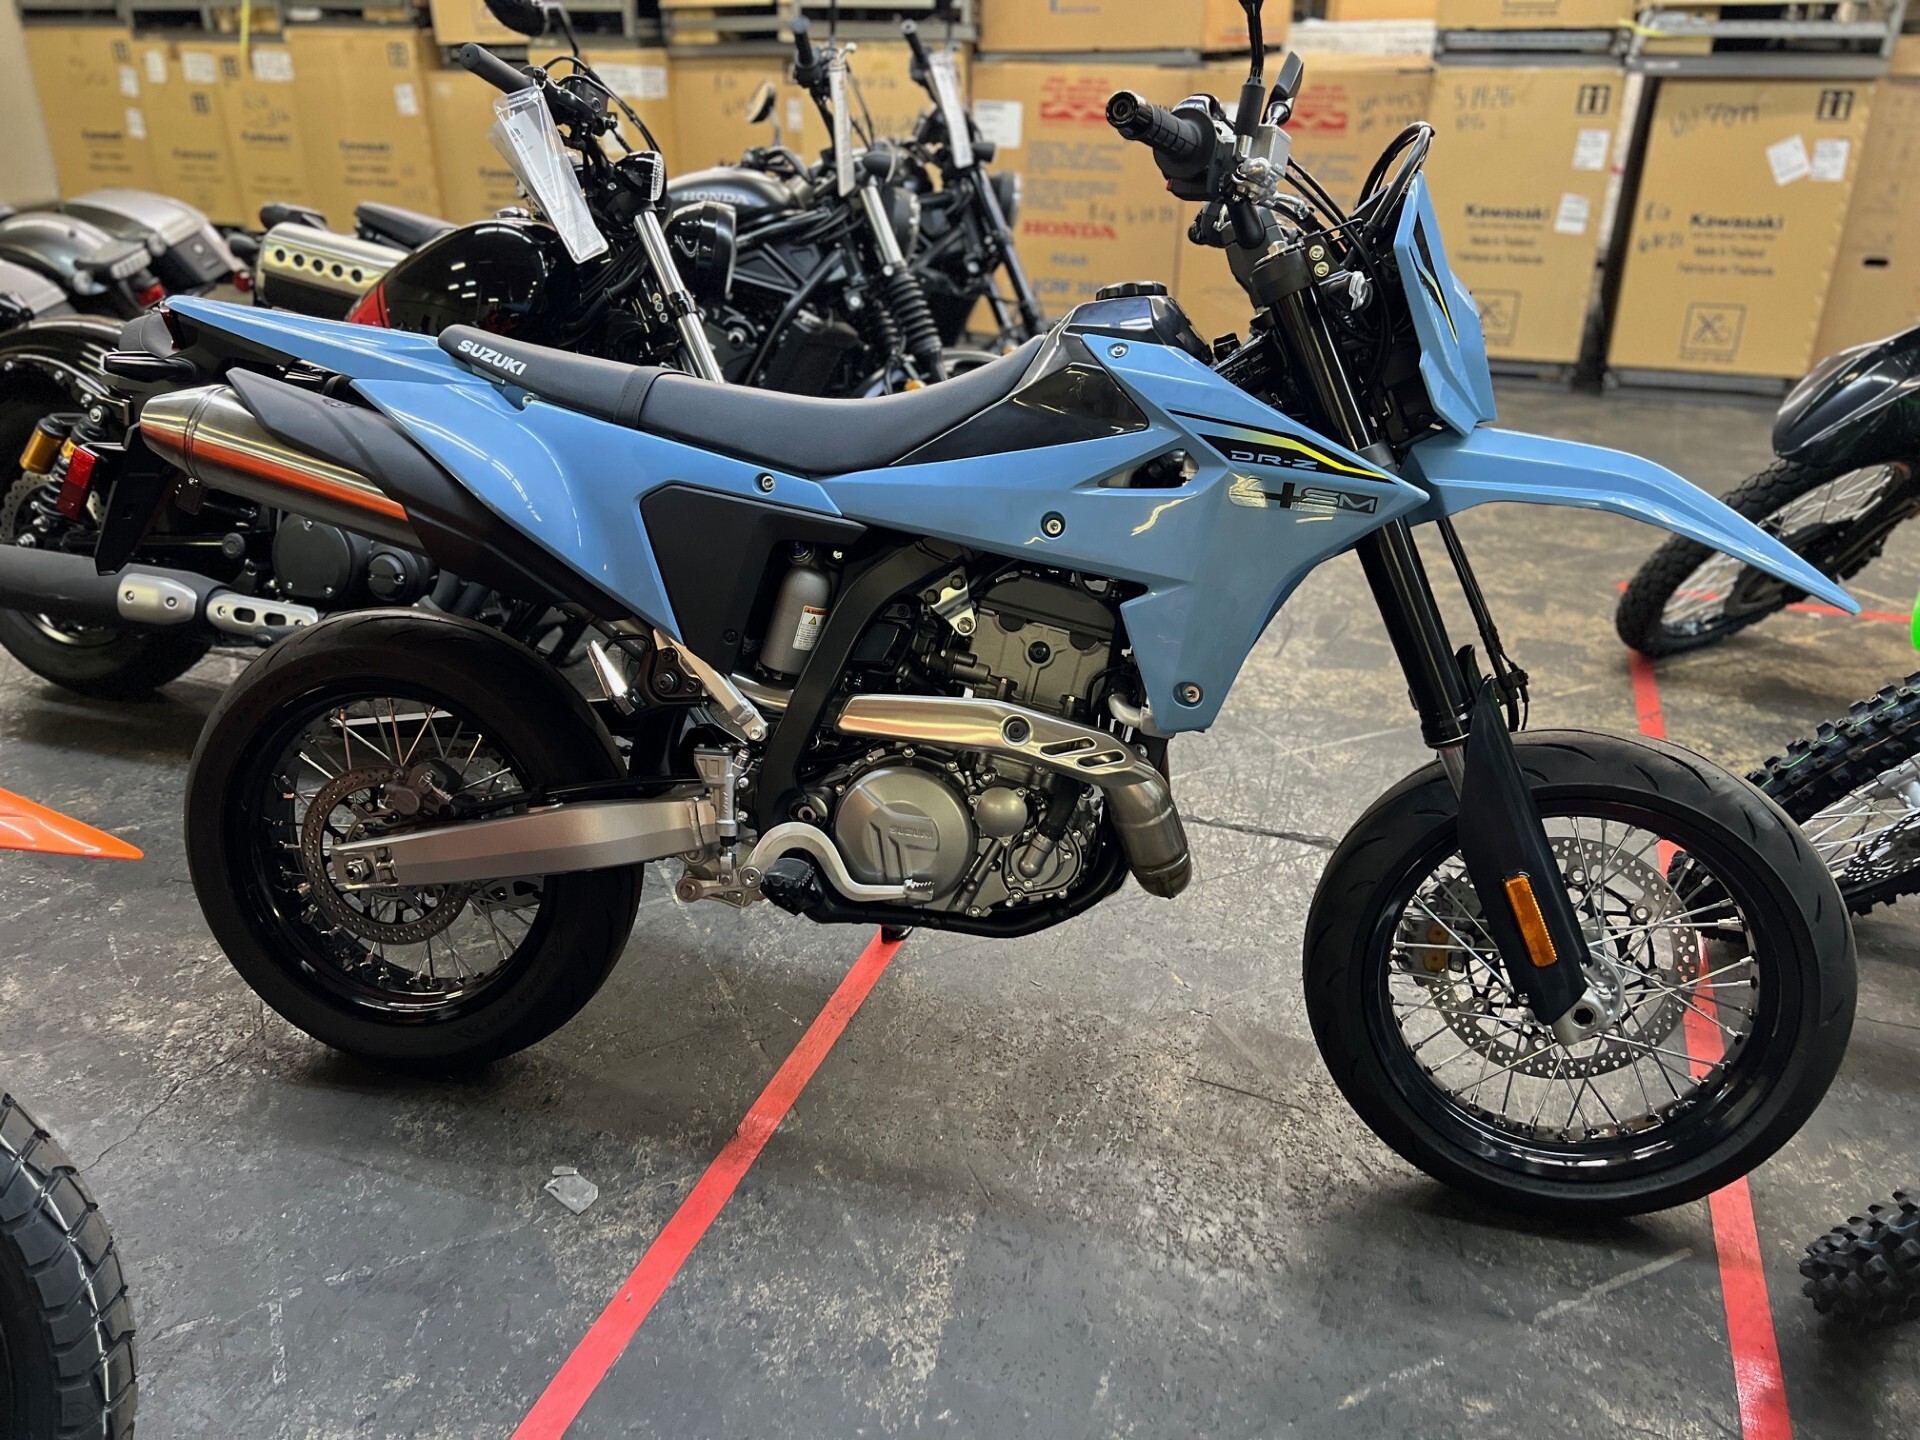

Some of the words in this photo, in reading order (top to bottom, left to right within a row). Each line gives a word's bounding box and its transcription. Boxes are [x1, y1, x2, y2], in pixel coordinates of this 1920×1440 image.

[681, 191, 750, 205] HONDA
[1465, 203, 1551, 220] Kawasaki
[1023, 219, 1117, 241] HONDA
[1690, 212, 1783, 231] Kawasaki
[457, 340, 527, 376] SUZUKI
[1230, 450, 1318, 470] DR-Z
[888, 825, 934, 840] SUZUKI
